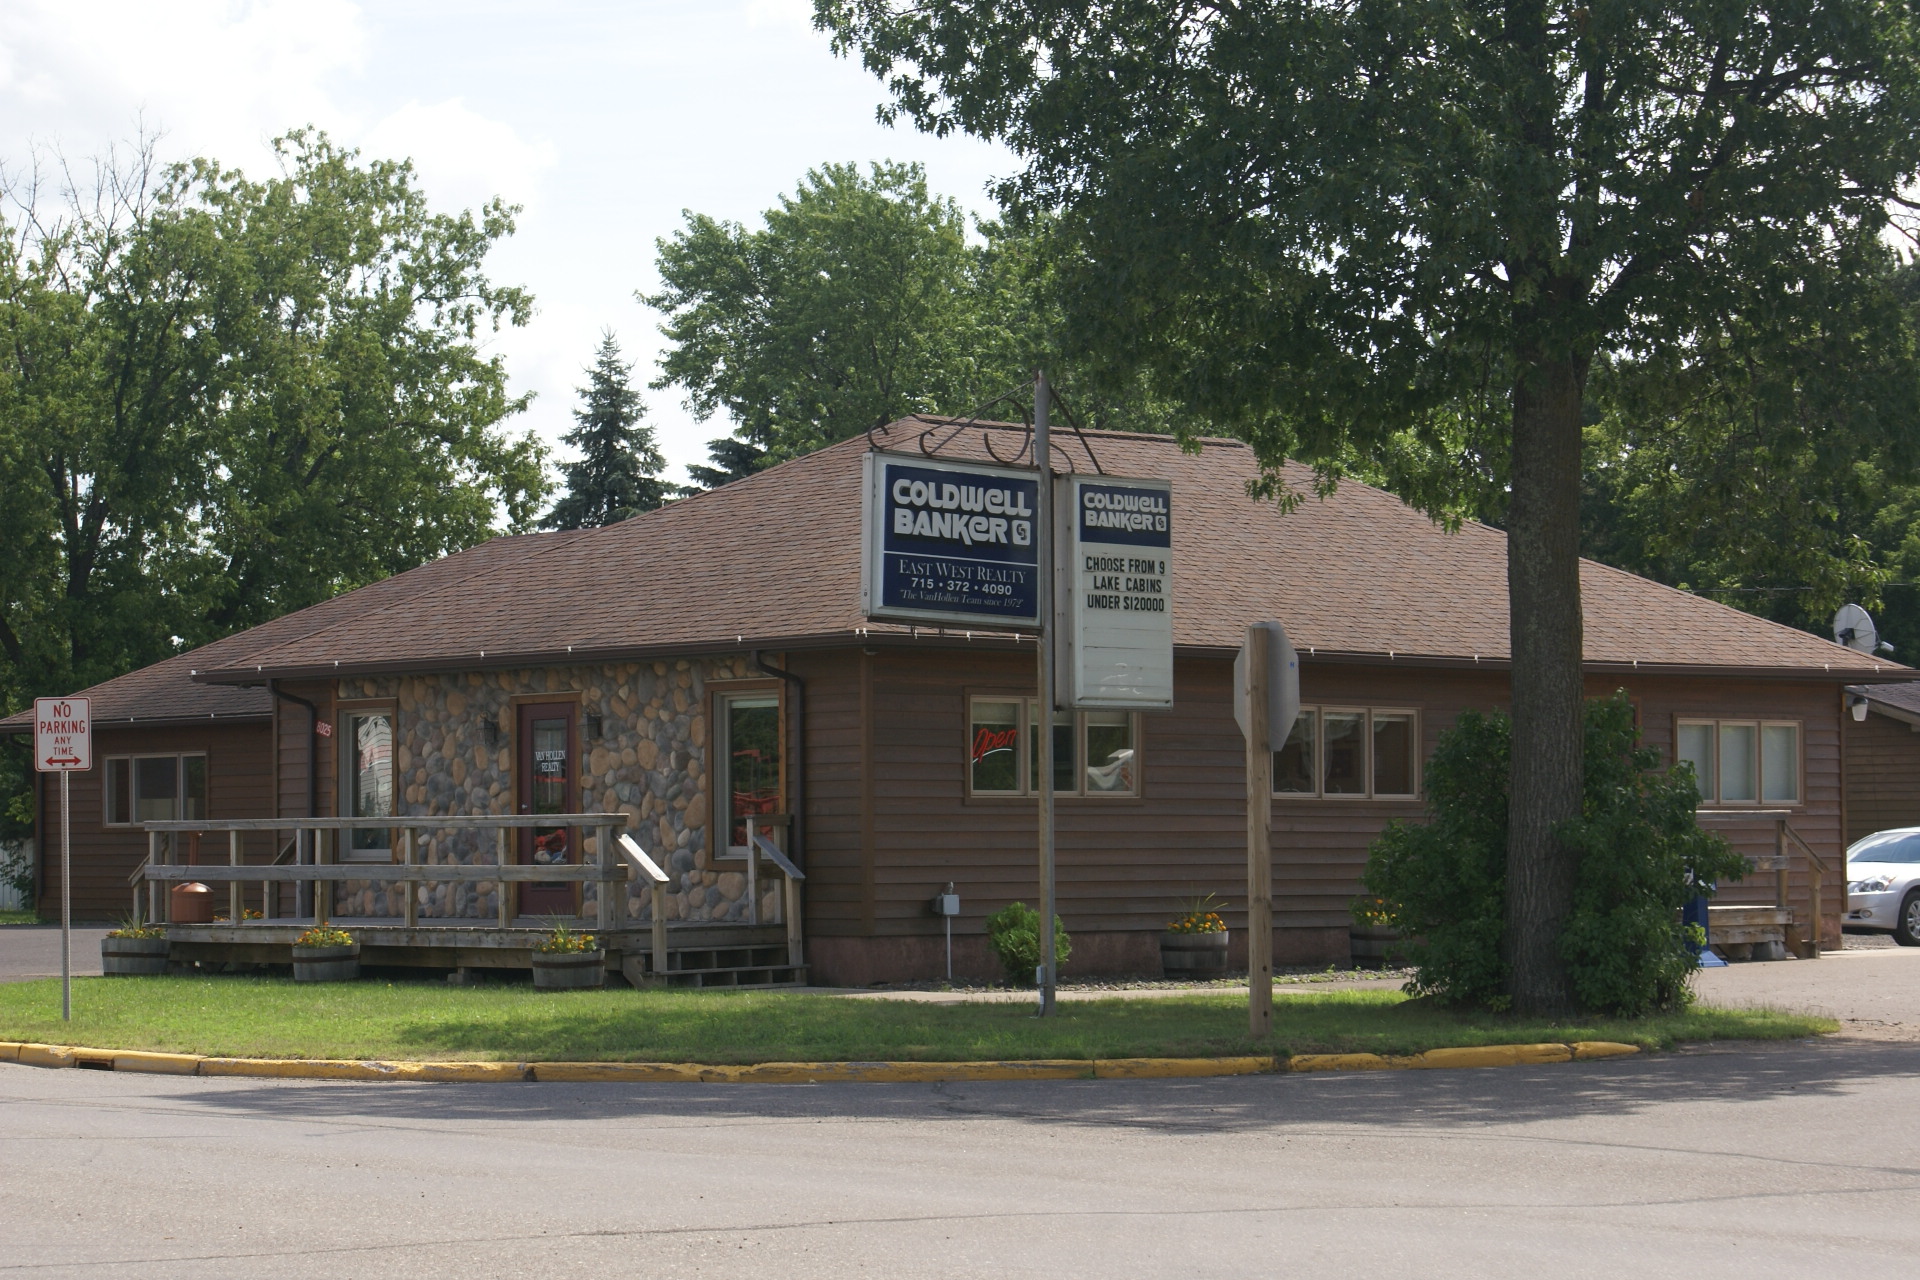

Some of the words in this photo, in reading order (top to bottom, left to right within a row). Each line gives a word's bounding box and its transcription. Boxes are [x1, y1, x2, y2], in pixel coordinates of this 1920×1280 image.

[892, 479, 1032, 517] COLDWELL
[1083, 492, 1167, 514] COLDWELL
[893, 508, 1008, 546] BANKER
[1085, 510, 1153, 532] BANKER
[899, 559, 933, 576] EAST
[936, 562, 974, 580] WEST
[977, 566, 1026, 583] REALTY
[1086, 556, 1125, 572] CHOOSE
[1128, 559, 1155, 574] FROM
[1159, 561, 1165, 575] 9
[911, 577, 934, 589] 715
[947, 580, 970, 592] 372
[982, 583, 1012, 595] 4090
[1093, 575, 1120, 591] LAKE
[1126, 577, 1162, 593] CABINS
[961, 594, 982, 605] Team
[983, 596, 1001, 606] since
[1087, 594, 1120, 609] UNDER
[53, 704, 71, 718] NO
[40, 720, 85, 734] PARKING
[54, 736, 71, 745] ANY
[972, 728, 1017, 764] Open
[53, 746, 73, 756] TIME
[535, 751, 545, 761] VAN
[545, 750, 566, 761] HOLLEN
[541, 761, 560, 772] REALTY
